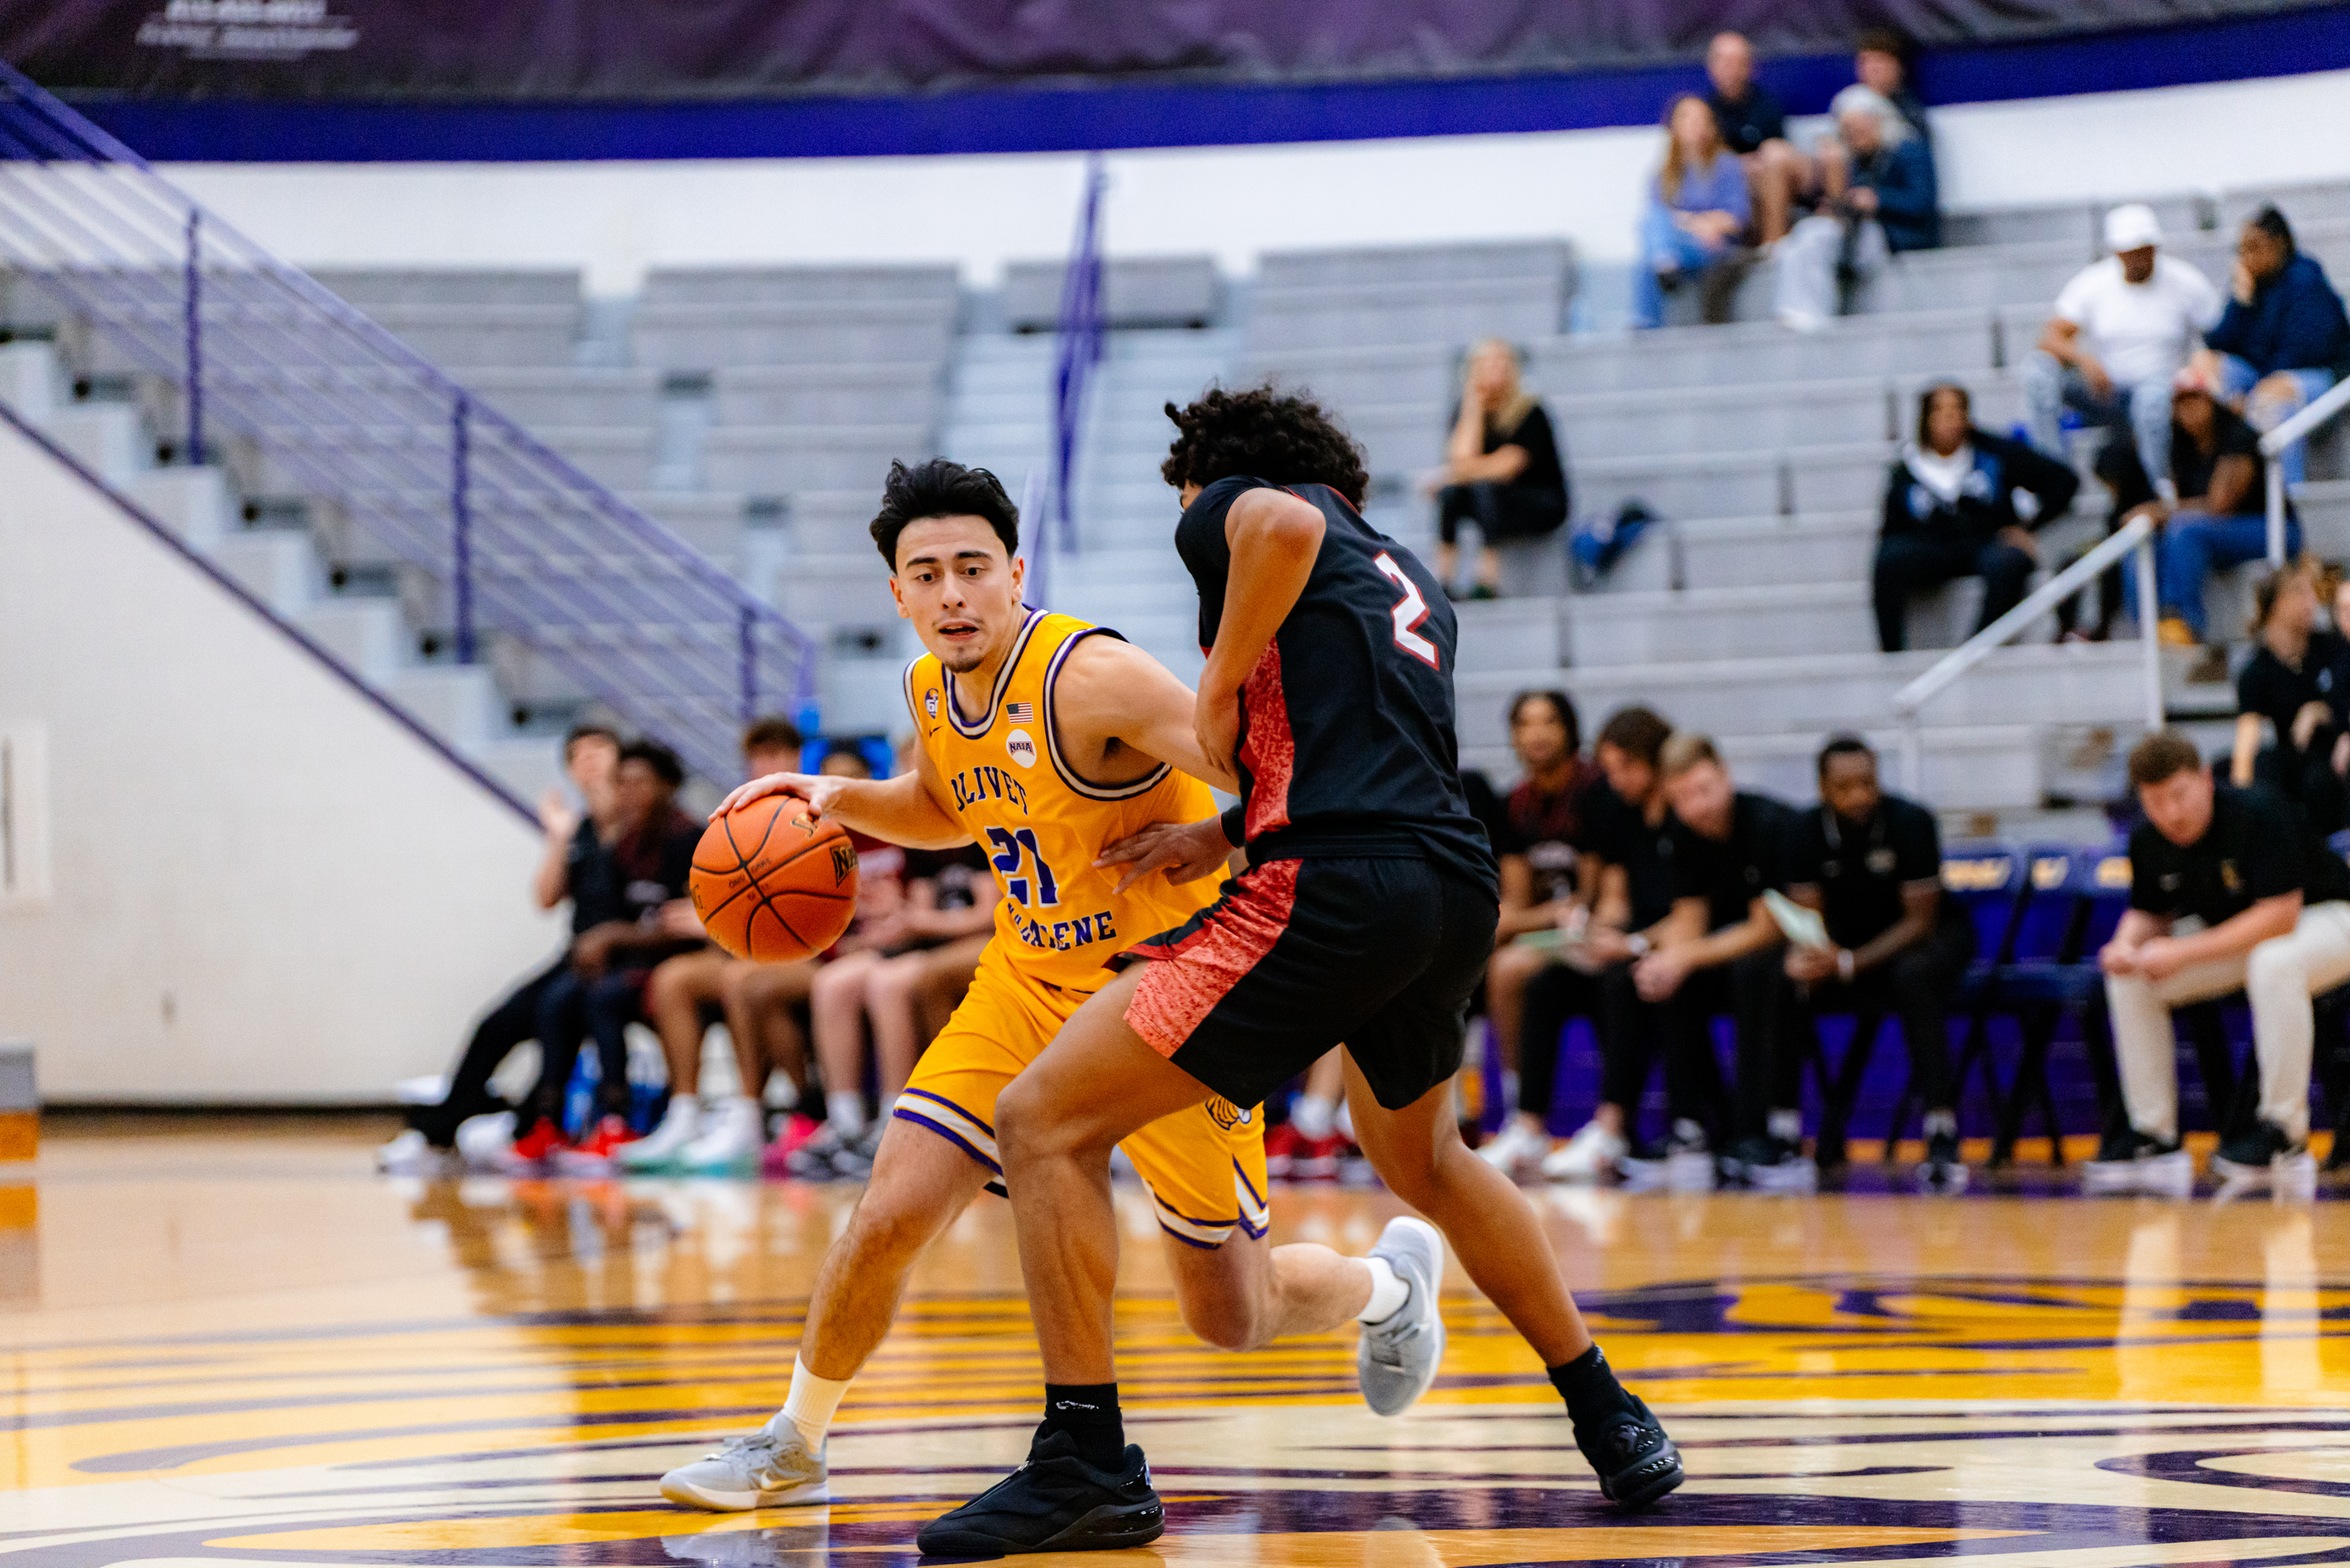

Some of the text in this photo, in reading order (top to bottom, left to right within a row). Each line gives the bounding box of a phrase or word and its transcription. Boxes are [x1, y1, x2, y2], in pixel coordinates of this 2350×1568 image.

[1371, 548, 1440, 672] 2
[1008, 741, 1034, 756] NAIA
[984, 825, 1061, 908] 21
[1006, 902, 1117, 951] AENE
